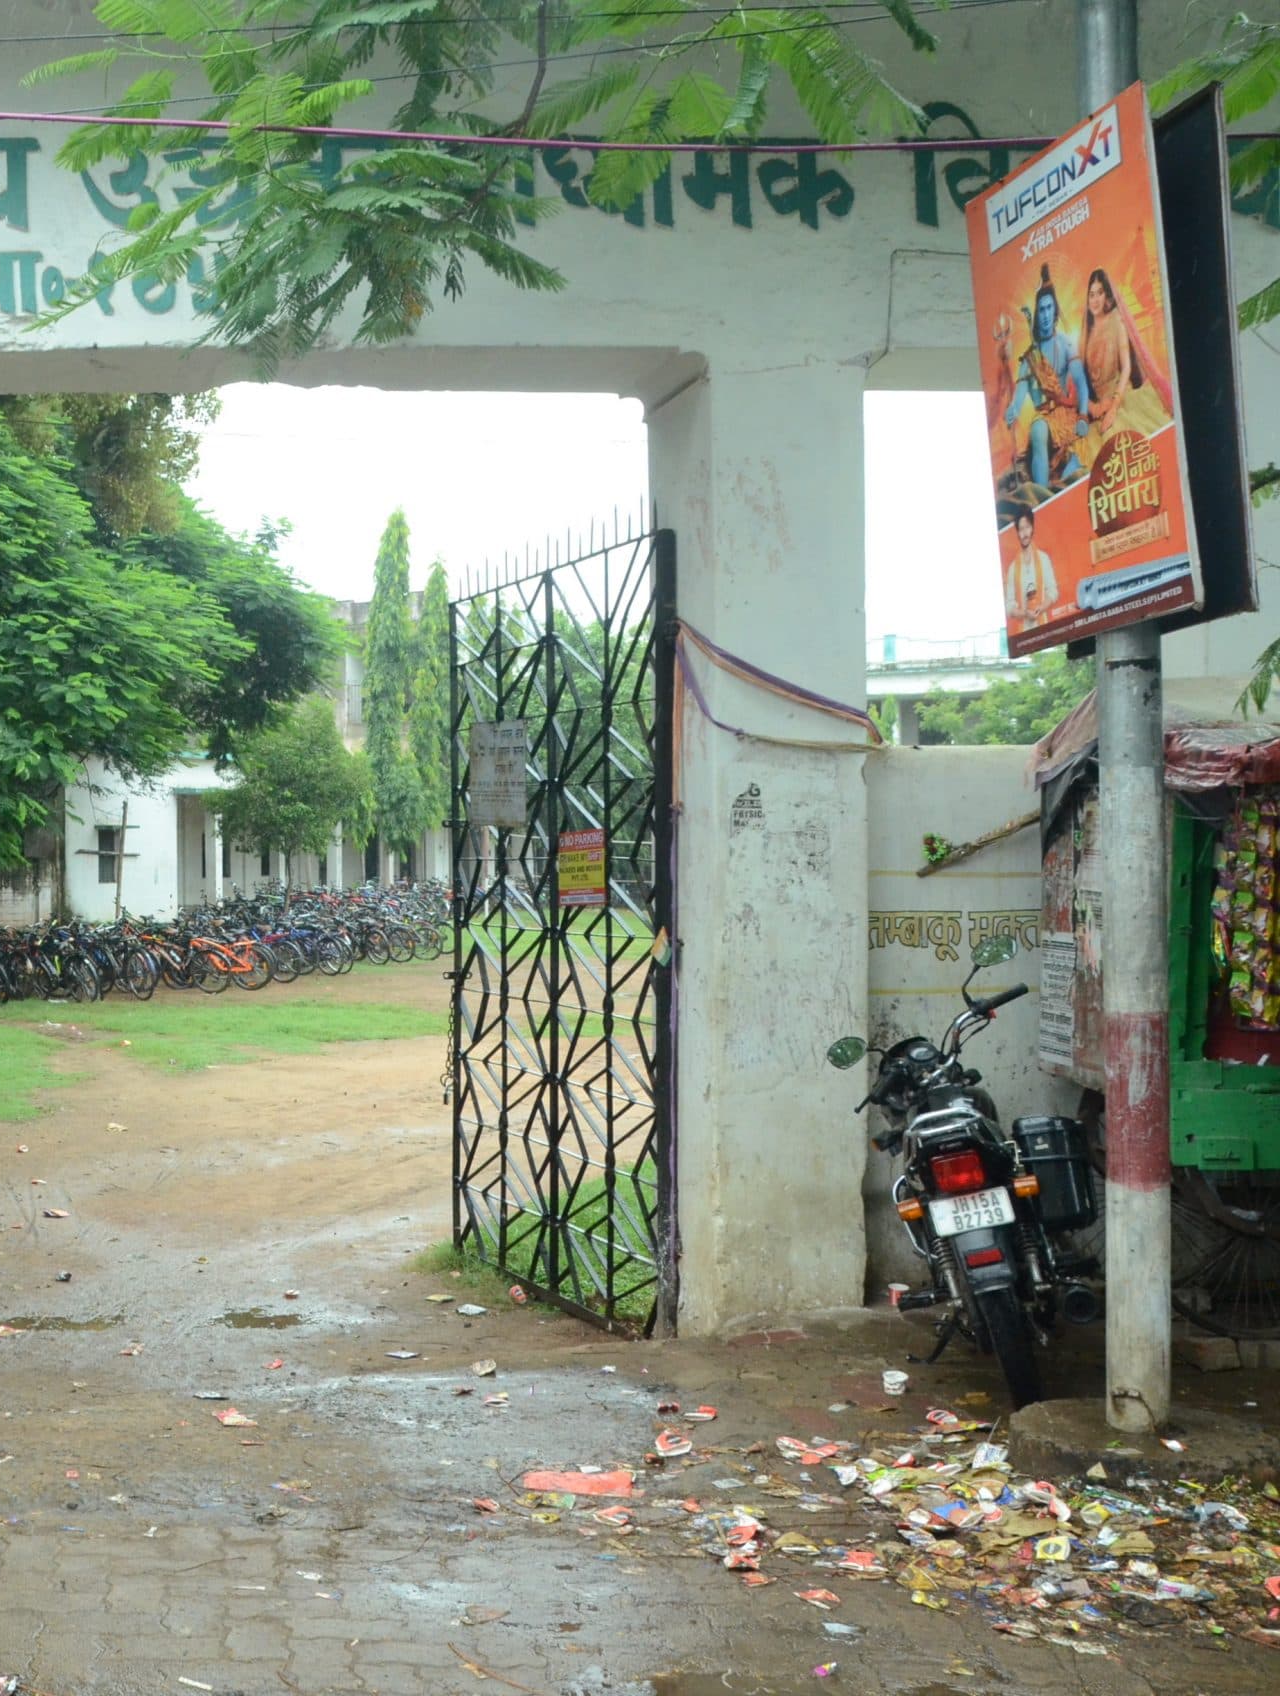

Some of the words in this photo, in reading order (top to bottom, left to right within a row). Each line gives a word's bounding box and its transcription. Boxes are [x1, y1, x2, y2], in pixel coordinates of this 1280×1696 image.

[1054, 203, 1090, 239] TOUGH
[1127, 452, 1160, 479] नमः
[1088, 473, 1161, 531] शिवाय
[574, 831, 603, 846] PARKING
[951, 1190, 1001, 1215] JH15A
[953, 1206, 1005, 1231] B2739
